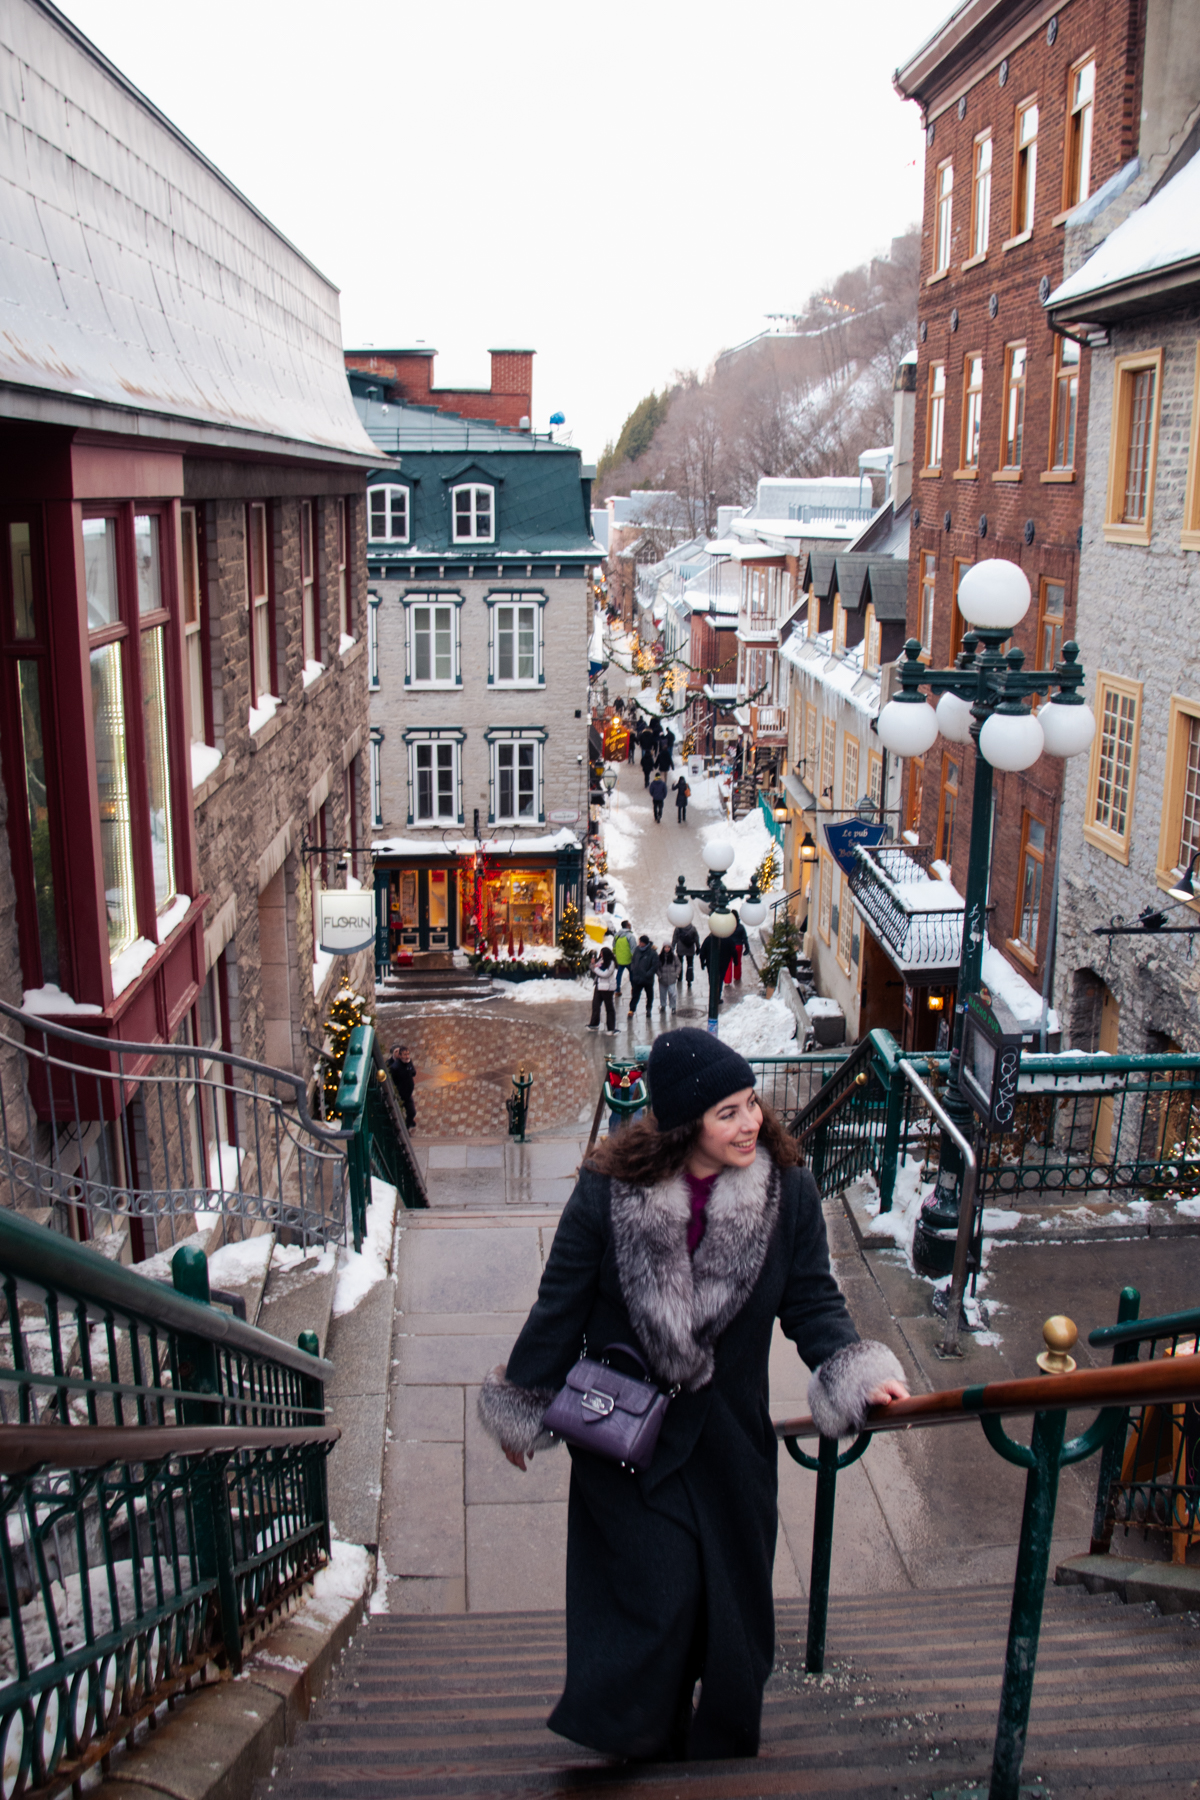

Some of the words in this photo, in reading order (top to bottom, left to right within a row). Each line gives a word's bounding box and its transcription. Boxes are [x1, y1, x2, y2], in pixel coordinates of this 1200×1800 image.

[842, 829, 852, 837] Le
[853, 828, 868, 838] pub
[324, 916, 370, 928] FLORIN
[968, 995, 987, 1020] NACHO
[988, 1015, 999, 1033] PUB
